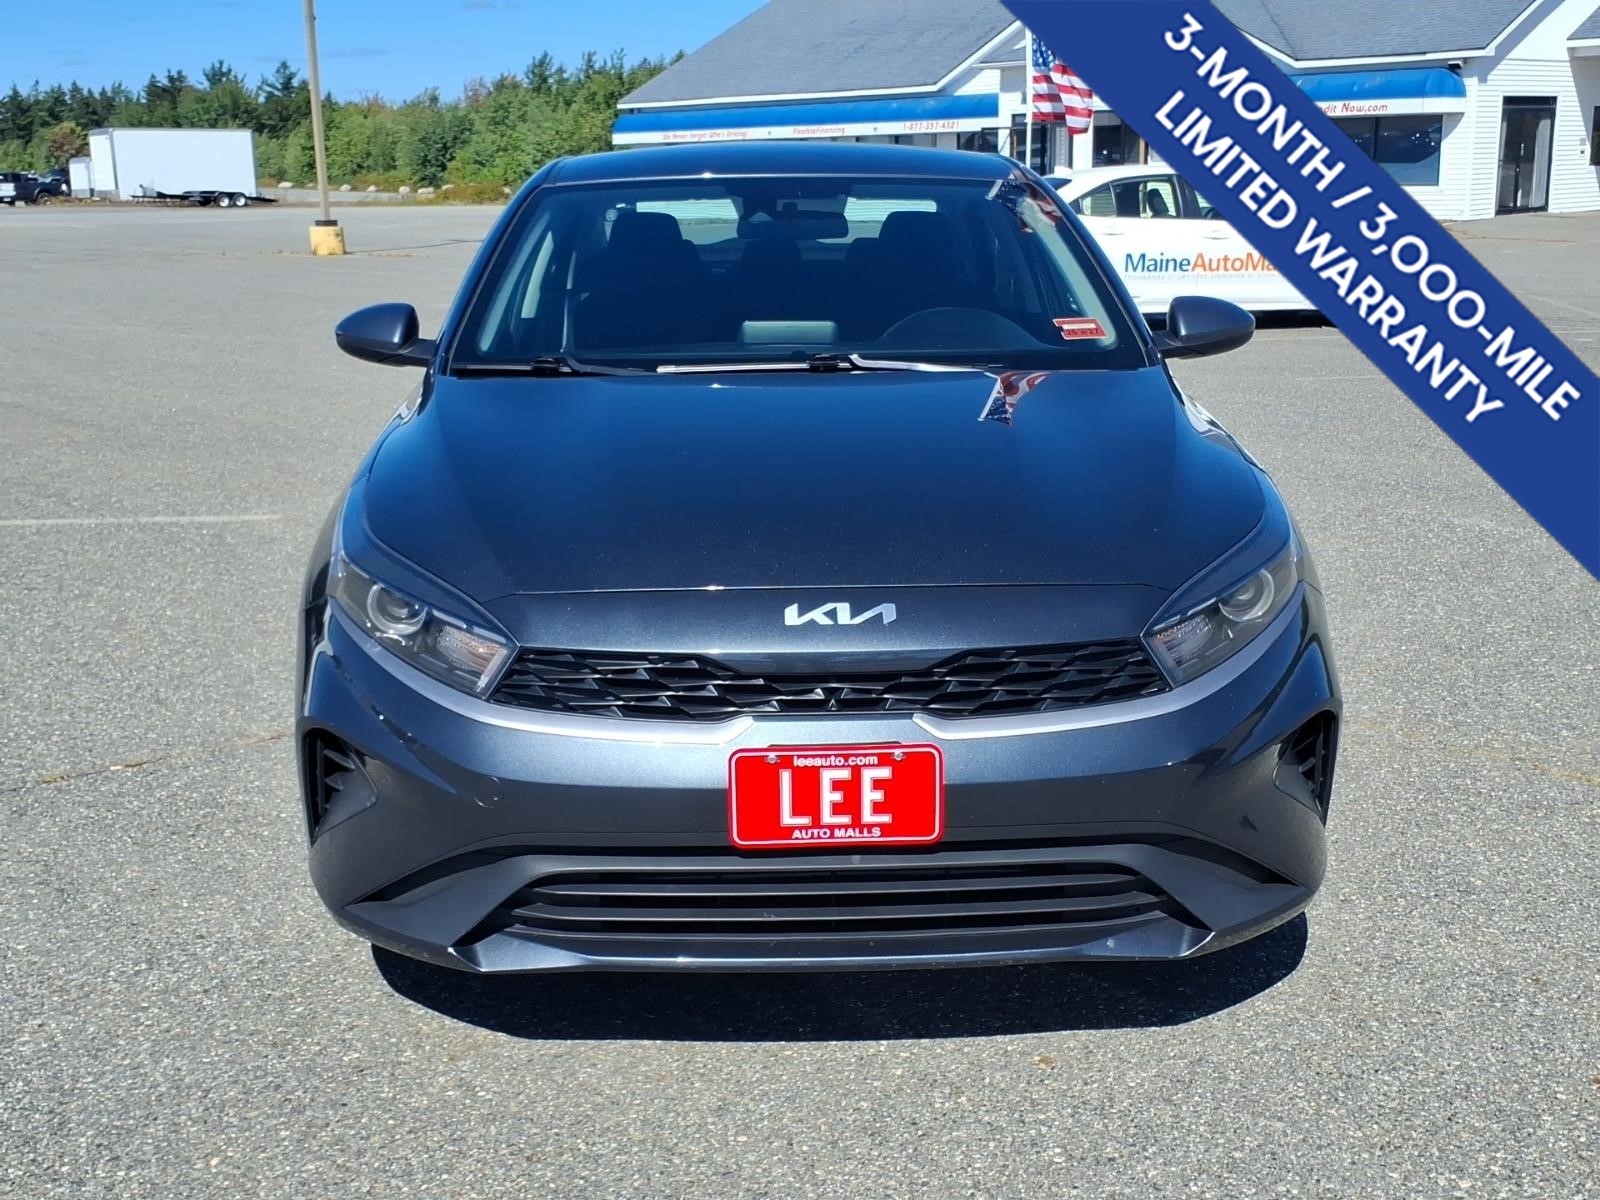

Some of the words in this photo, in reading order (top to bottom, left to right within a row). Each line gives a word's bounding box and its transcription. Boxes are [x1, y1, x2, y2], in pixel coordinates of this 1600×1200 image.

[1341, 102, 1388, 113] Now.com
[784, 602, 897, 626] KIA
[793, 755, 878, 768] leeauto.com
[779, 766, 893, 827] LEE
[791, 828, 831, 840] AUTO
[833, 827, 882, 839] MALLS
